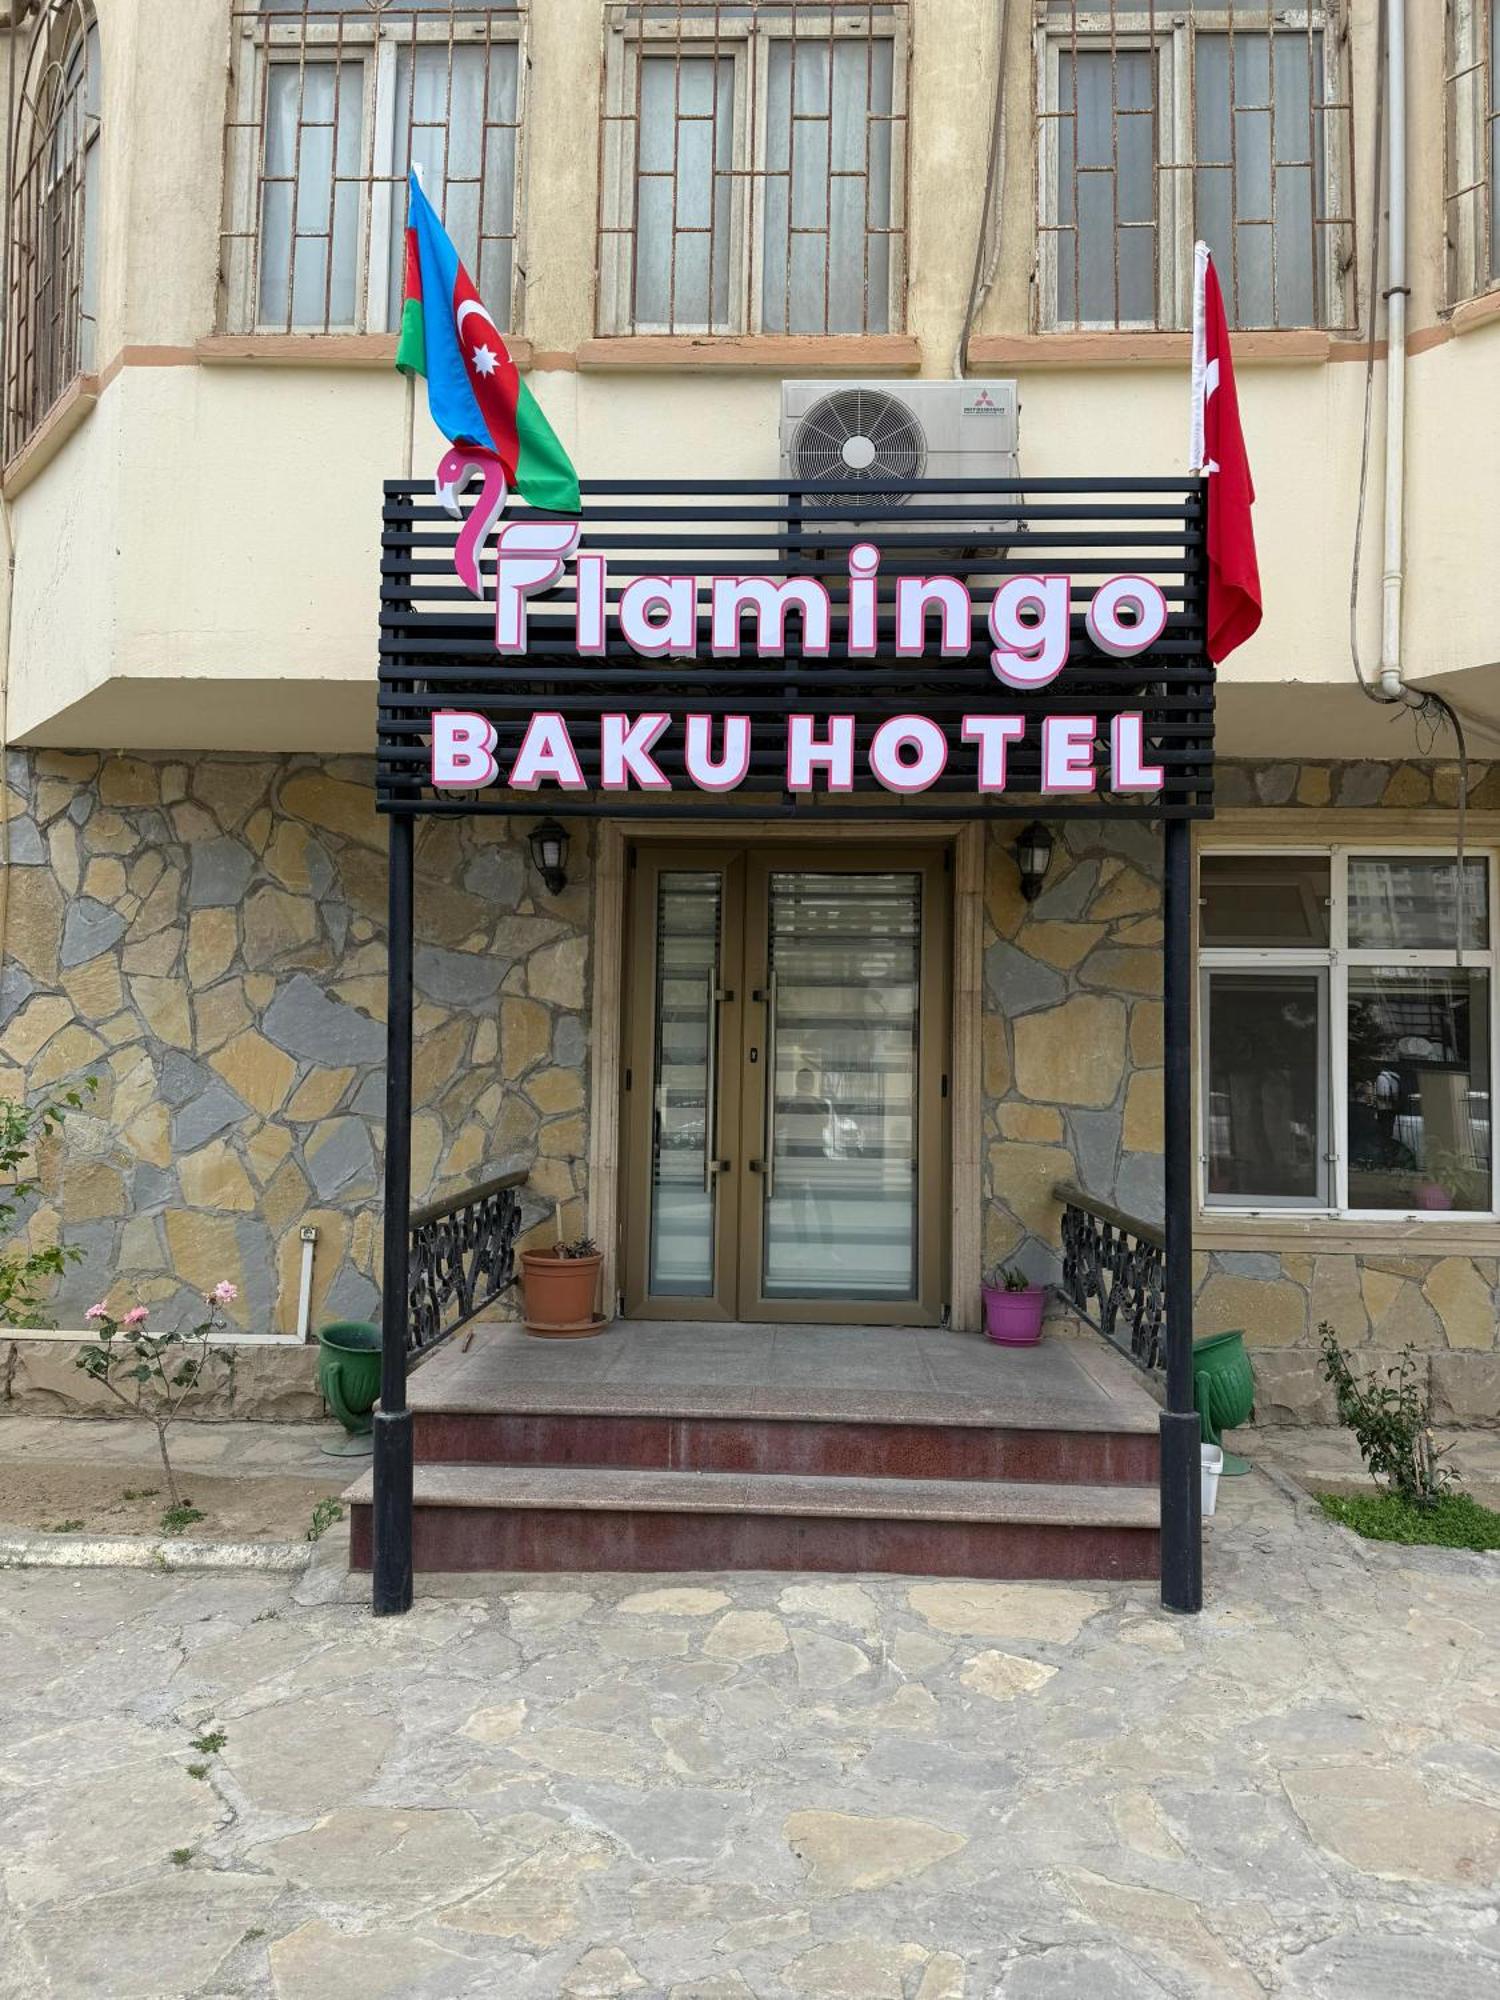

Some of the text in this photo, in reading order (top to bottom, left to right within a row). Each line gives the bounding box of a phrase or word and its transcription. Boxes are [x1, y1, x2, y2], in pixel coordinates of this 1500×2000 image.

[496, 523, 1168, 689] Flamingo
[432, 712, 1165, 795] BAKU HOTEL
